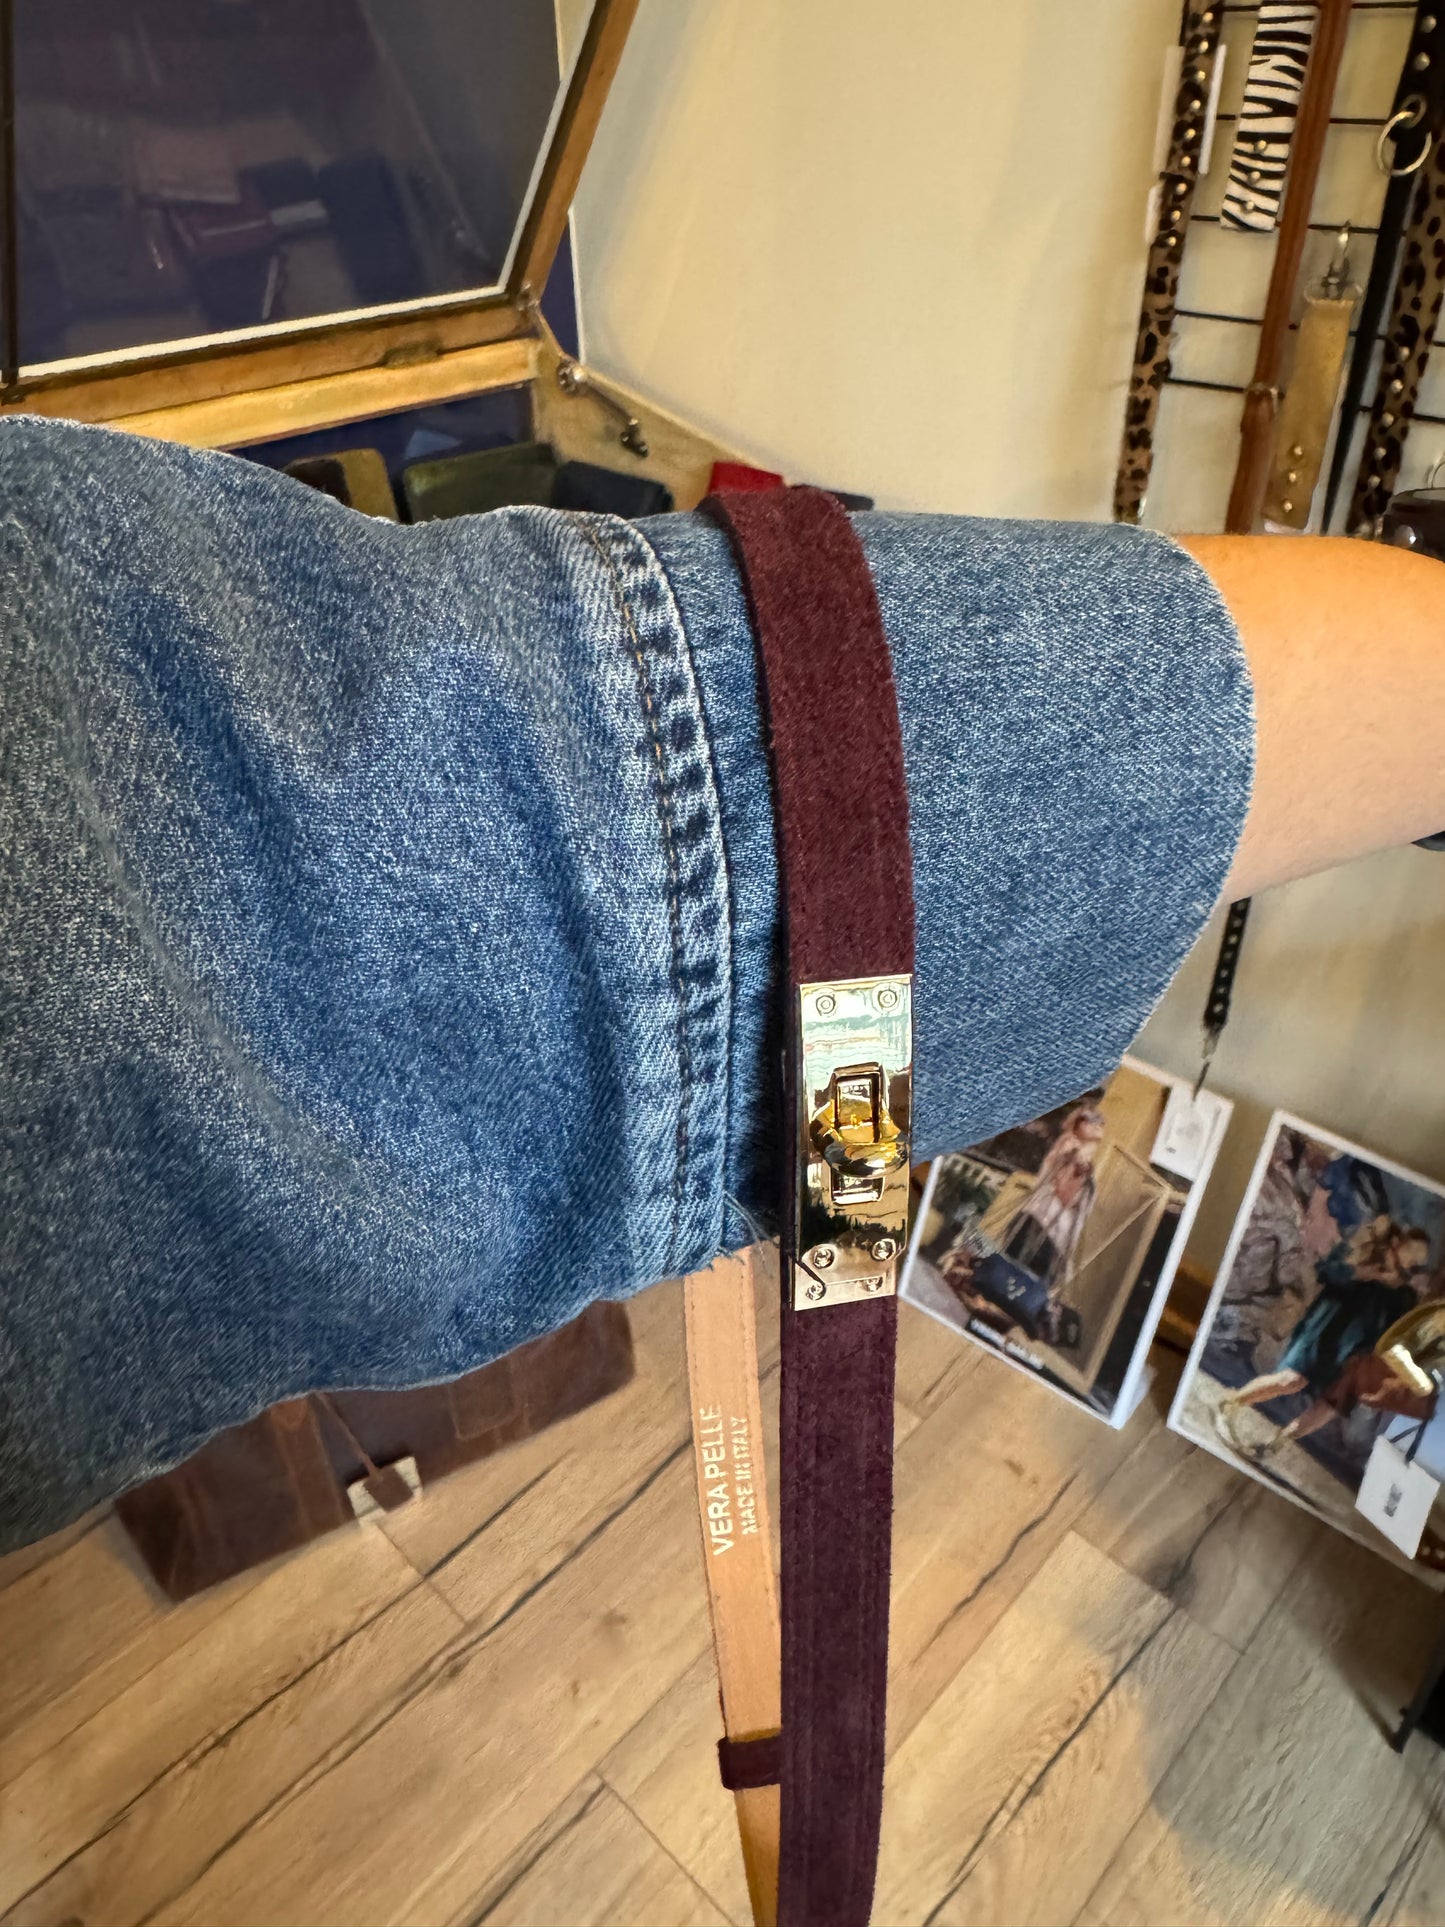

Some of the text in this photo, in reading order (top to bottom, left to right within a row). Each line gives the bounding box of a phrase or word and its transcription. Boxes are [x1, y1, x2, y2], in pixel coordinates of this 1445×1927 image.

[700, 1404, 735, 1556] VERA PELLE
[731, 1417, 758, 1535] MADE IN ITALY
